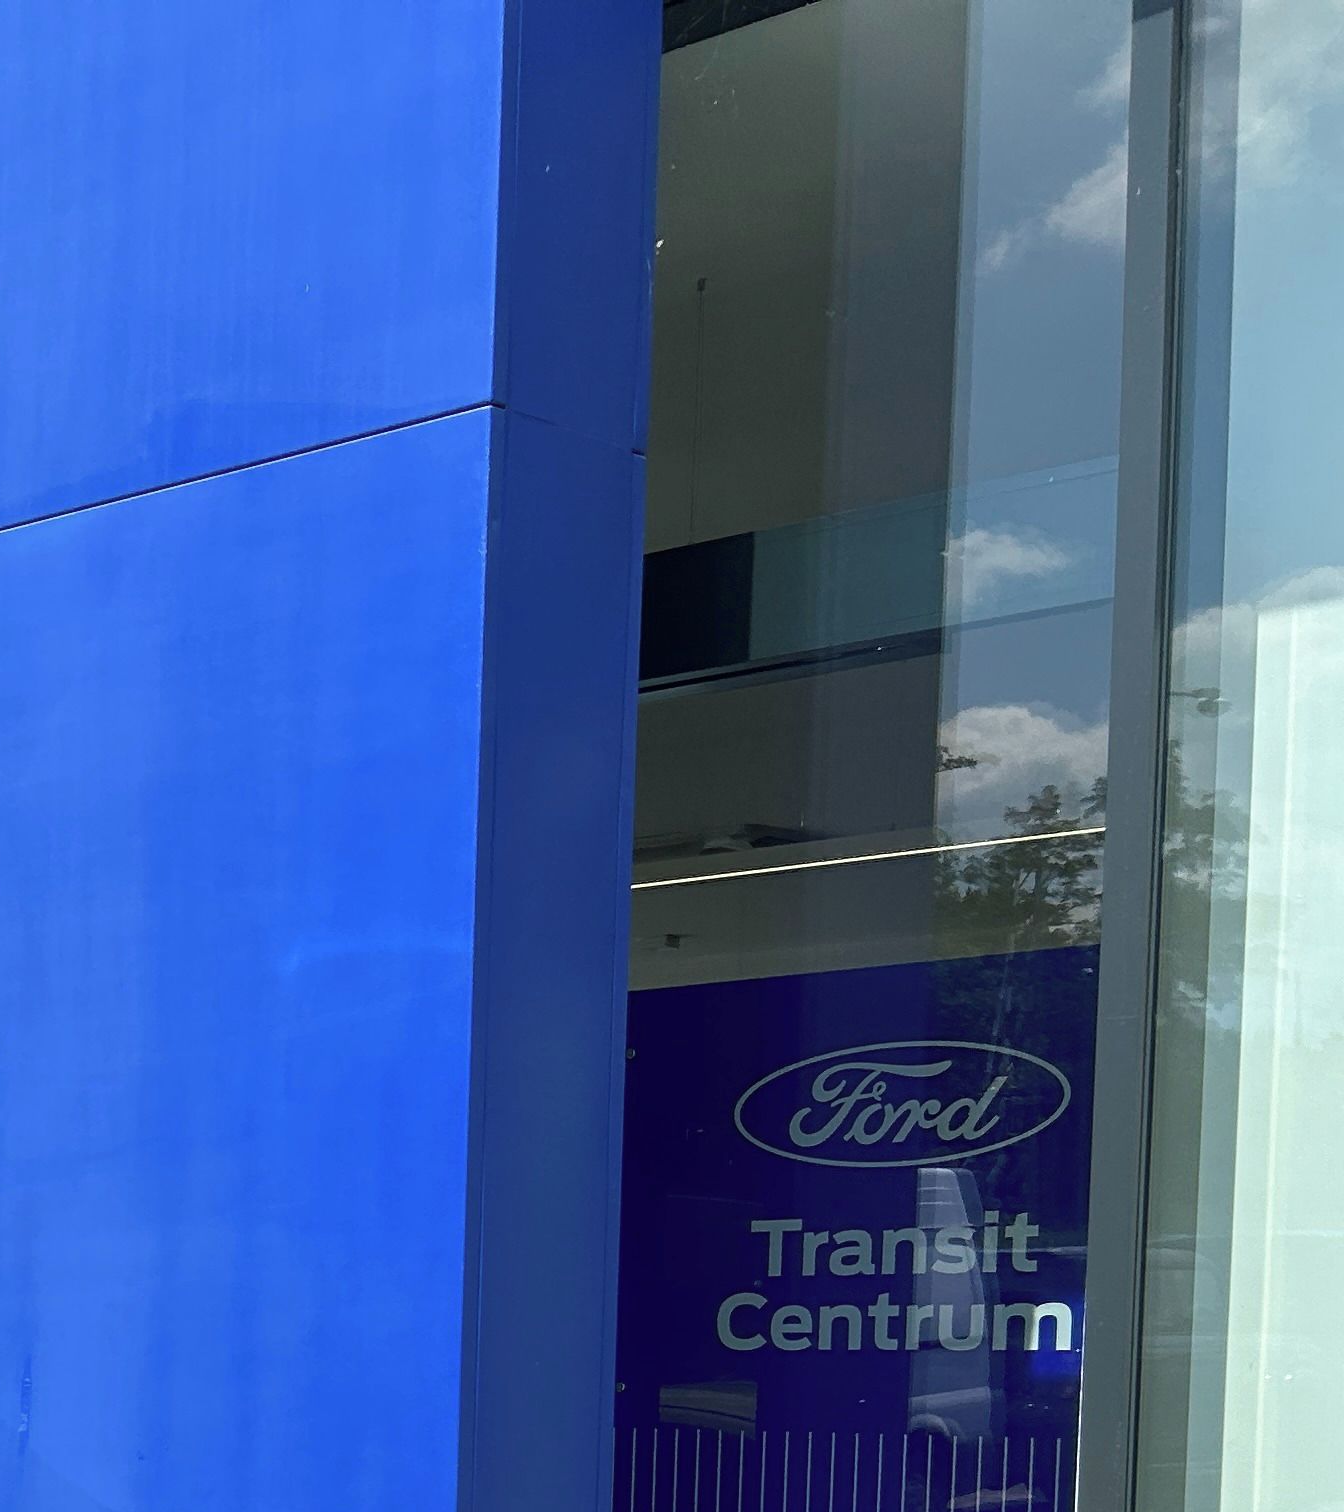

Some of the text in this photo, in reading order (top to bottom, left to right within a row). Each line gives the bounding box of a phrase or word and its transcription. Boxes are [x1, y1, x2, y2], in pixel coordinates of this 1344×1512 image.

[789, 1060, 1008, 1147] Ford
[751, 1211, 1040, 1277] Transit
[717, 1293, 1072, 1351] Centrum
